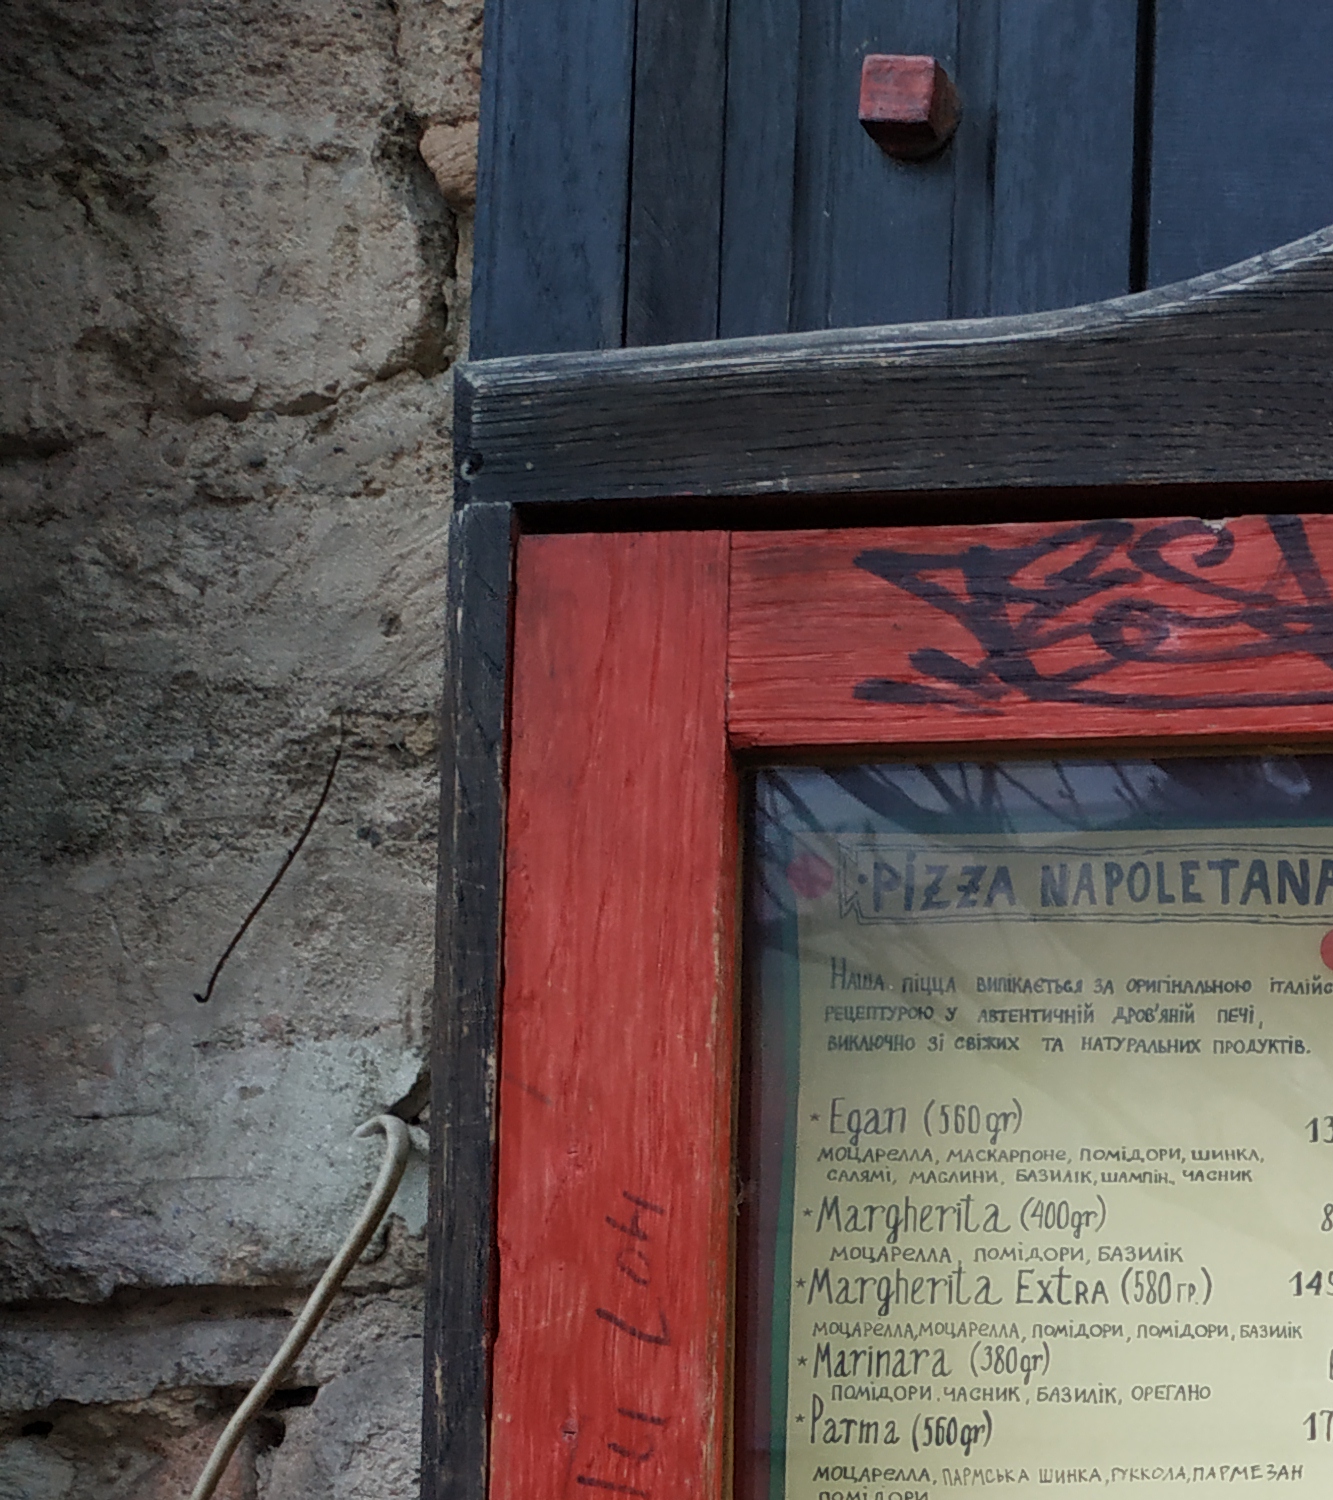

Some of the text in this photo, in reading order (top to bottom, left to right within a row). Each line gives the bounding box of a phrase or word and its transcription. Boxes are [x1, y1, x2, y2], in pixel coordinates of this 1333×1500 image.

[816, 1194, 1011, 1244] Margherita
[807, 1261, 1003, 1319] Margherita
[813, 1342, 952, 1378] Marinara
